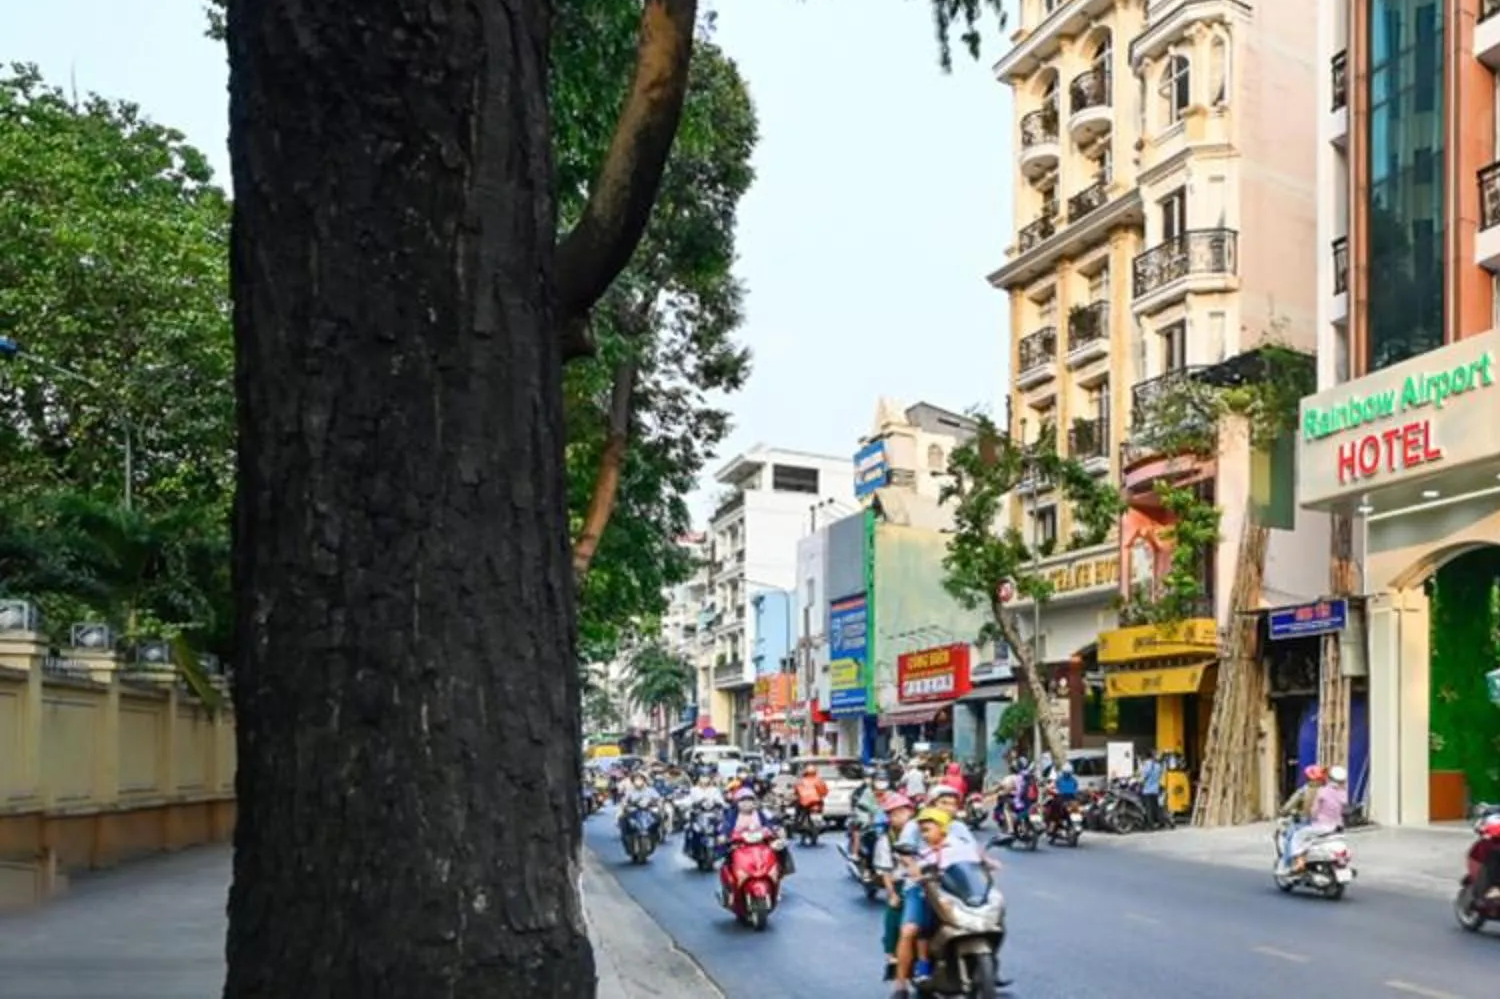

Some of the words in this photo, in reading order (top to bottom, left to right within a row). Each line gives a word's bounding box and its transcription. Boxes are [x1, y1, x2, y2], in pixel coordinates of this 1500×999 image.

[1303, 389, 1396, 442] Rainbow
[1401, 352, 1495, 412] Airport
[1337, 420, 1443, 485] HOTEL
